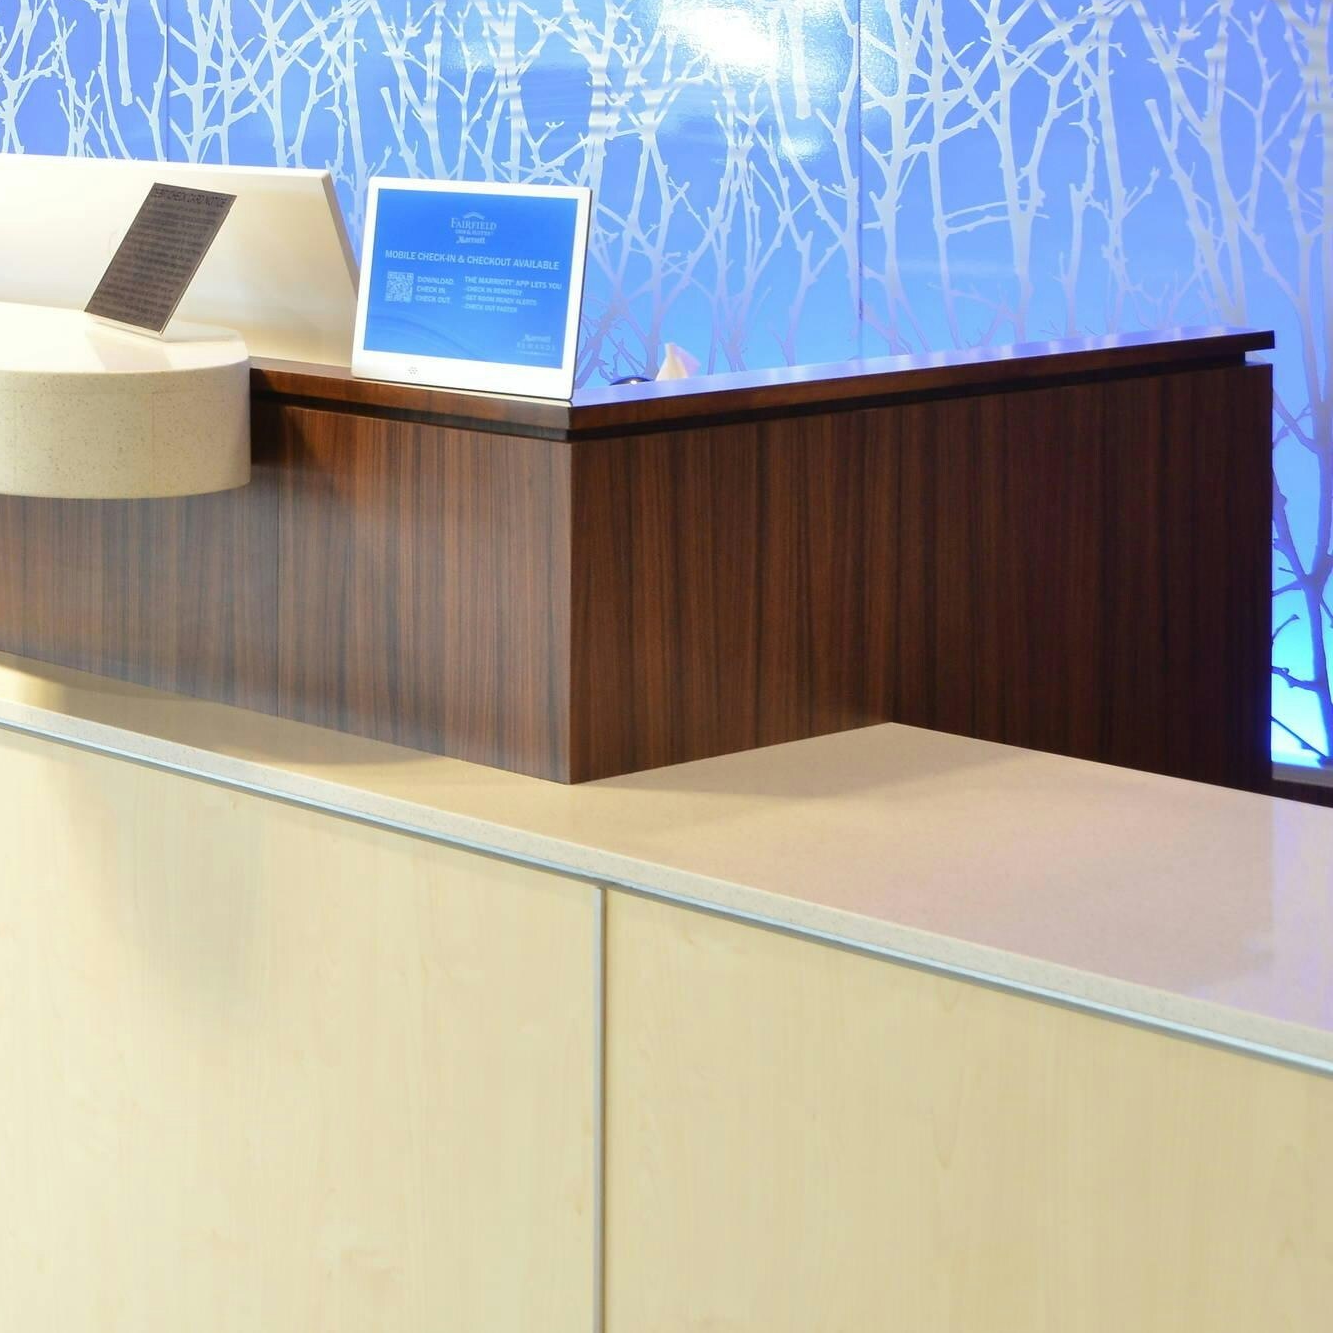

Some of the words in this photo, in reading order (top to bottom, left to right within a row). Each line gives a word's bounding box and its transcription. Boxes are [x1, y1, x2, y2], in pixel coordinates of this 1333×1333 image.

[451, 217, 497, 231] FAIRFIELD
[385, 250, 416, 260] MOBILE
[417, 252, 456, 263] CHECK-IN
[458, 255, 465, 264] &
[467, 256, 511, 266] CHECKOUT
[513, 259, 560, 270] AVAILABLE
[515, 279, 529, 287] APP
[548, 282, 562, 290] YOU
